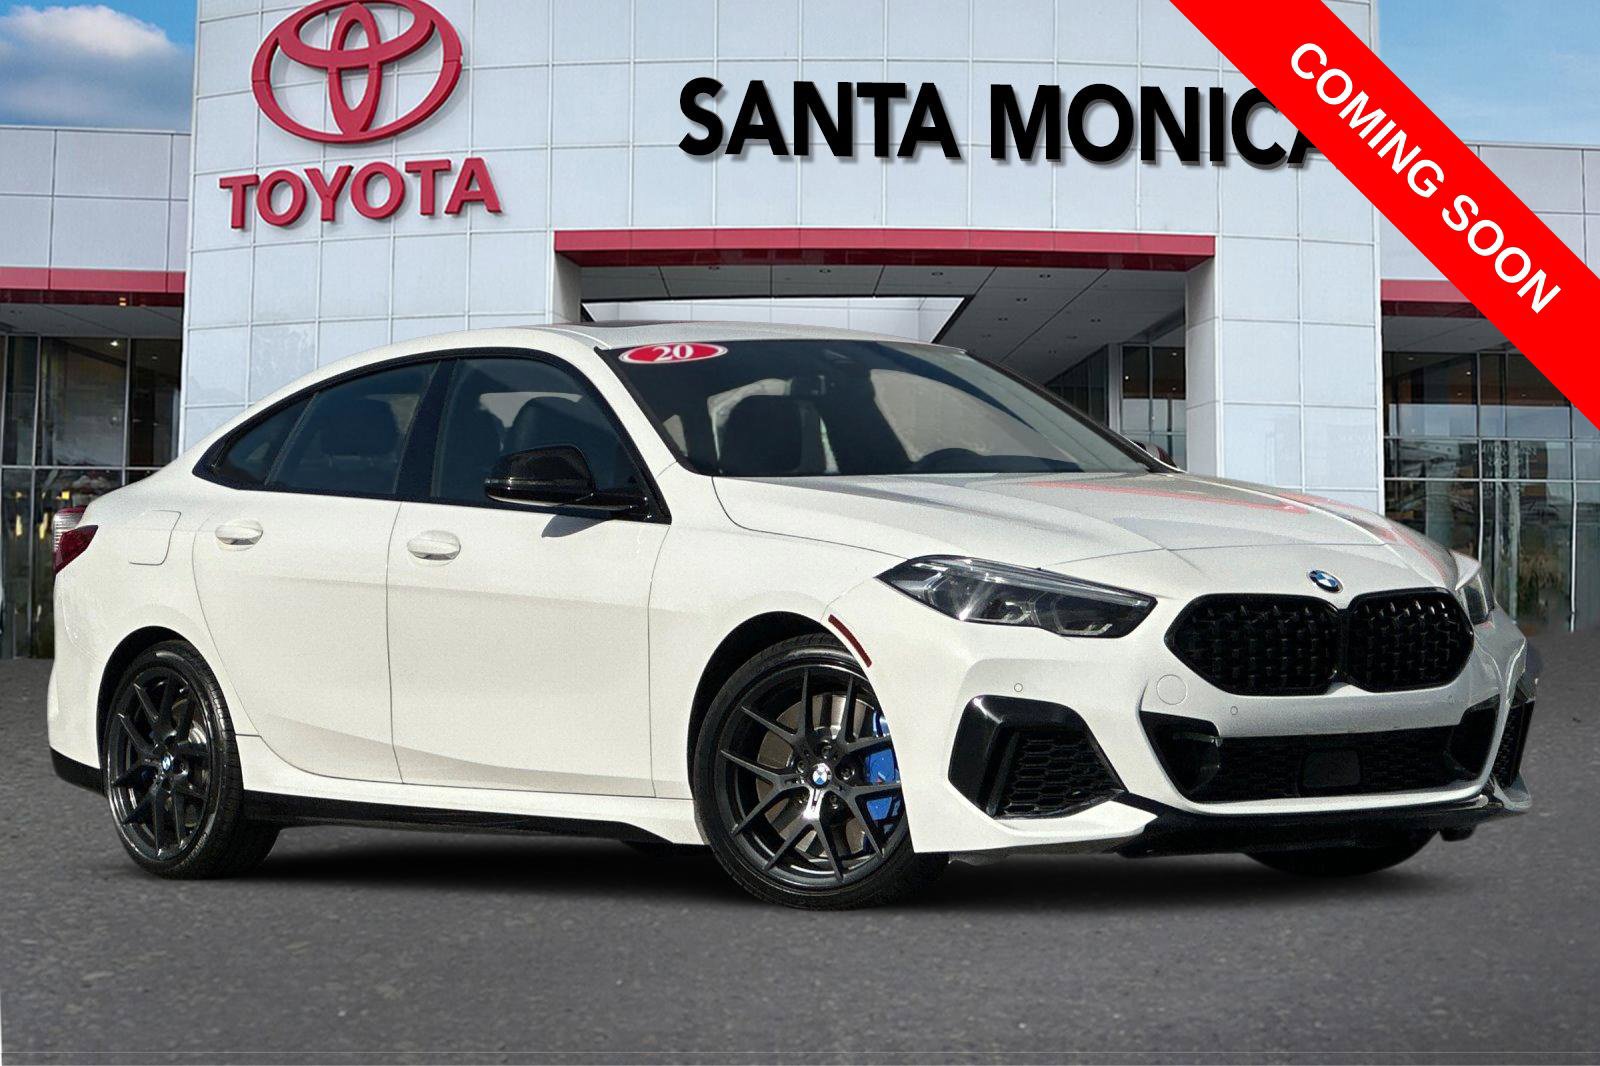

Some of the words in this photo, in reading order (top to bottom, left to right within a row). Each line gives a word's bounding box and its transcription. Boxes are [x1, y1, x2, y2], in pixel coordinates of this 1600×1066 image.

[678, 76, 961, 159] SANTA
[219, 157, 502, 230] TOYOTA
[652, 343, 694, 361] 20
